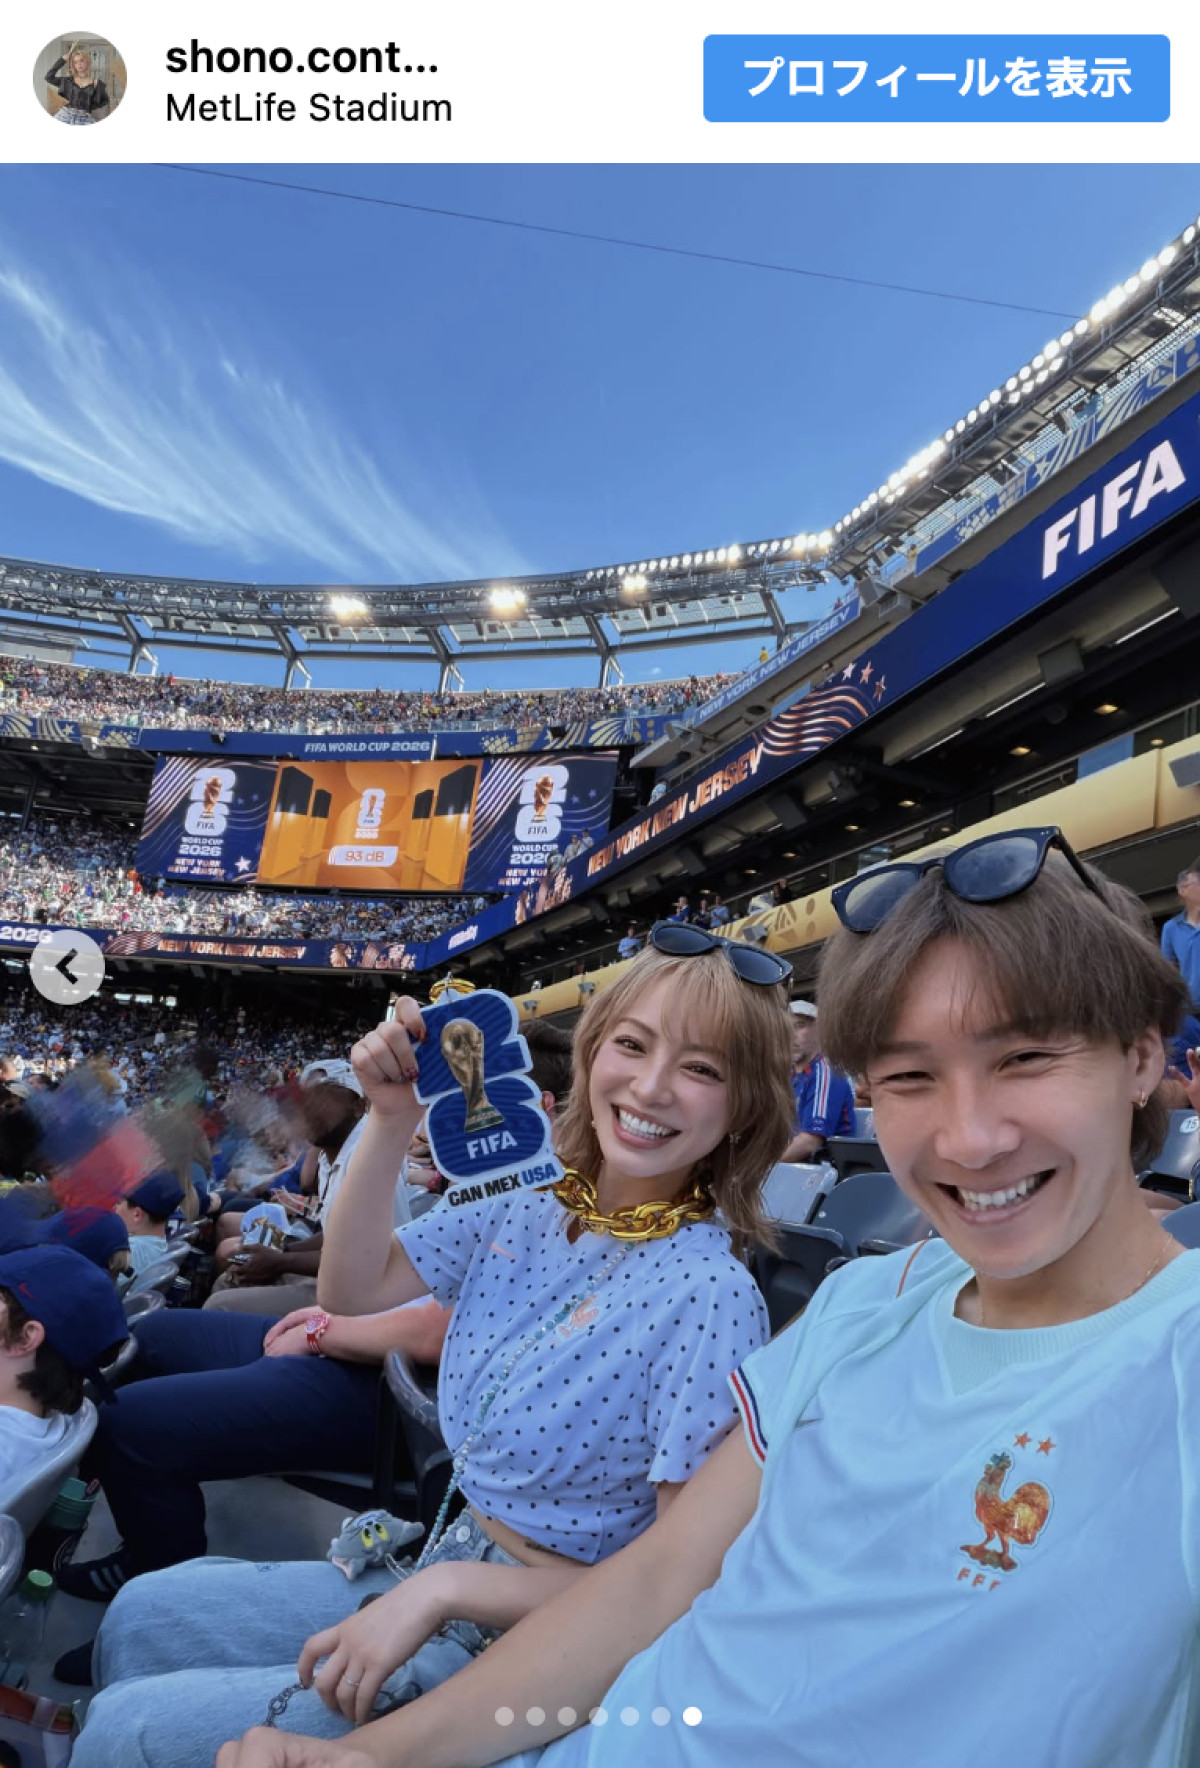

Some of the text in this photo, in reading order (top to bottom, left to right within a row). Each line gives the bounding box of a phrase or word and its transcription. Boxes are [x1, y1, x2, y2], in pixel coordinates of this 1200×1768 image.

[1042, 439, 1186, 580] FIFA
[700, 607, 850, 719] NEW YORK NEW JERSEY
[304, 741, 430, 752] FIFA WORLD CUP 2026
[587, 742, 764, 877] NEW YORK NEW JERSEY
[196, 821, 215, 830] FIFA
[527, 826, 548, 835] FIFA
[179, 844, 221, 857] 2026
[512, 844, 541, 852] WORLD
[346, 851, 384, 862] 93 dB
[157, 939, 187, 953] NEW
[189, 940, 224, 956] YORK
[257, 944, 306, 959] JERSEY
[466, 1130, 518, 1159] FIFA
[447, 1163, 557, 1207] CAN MEX USA
